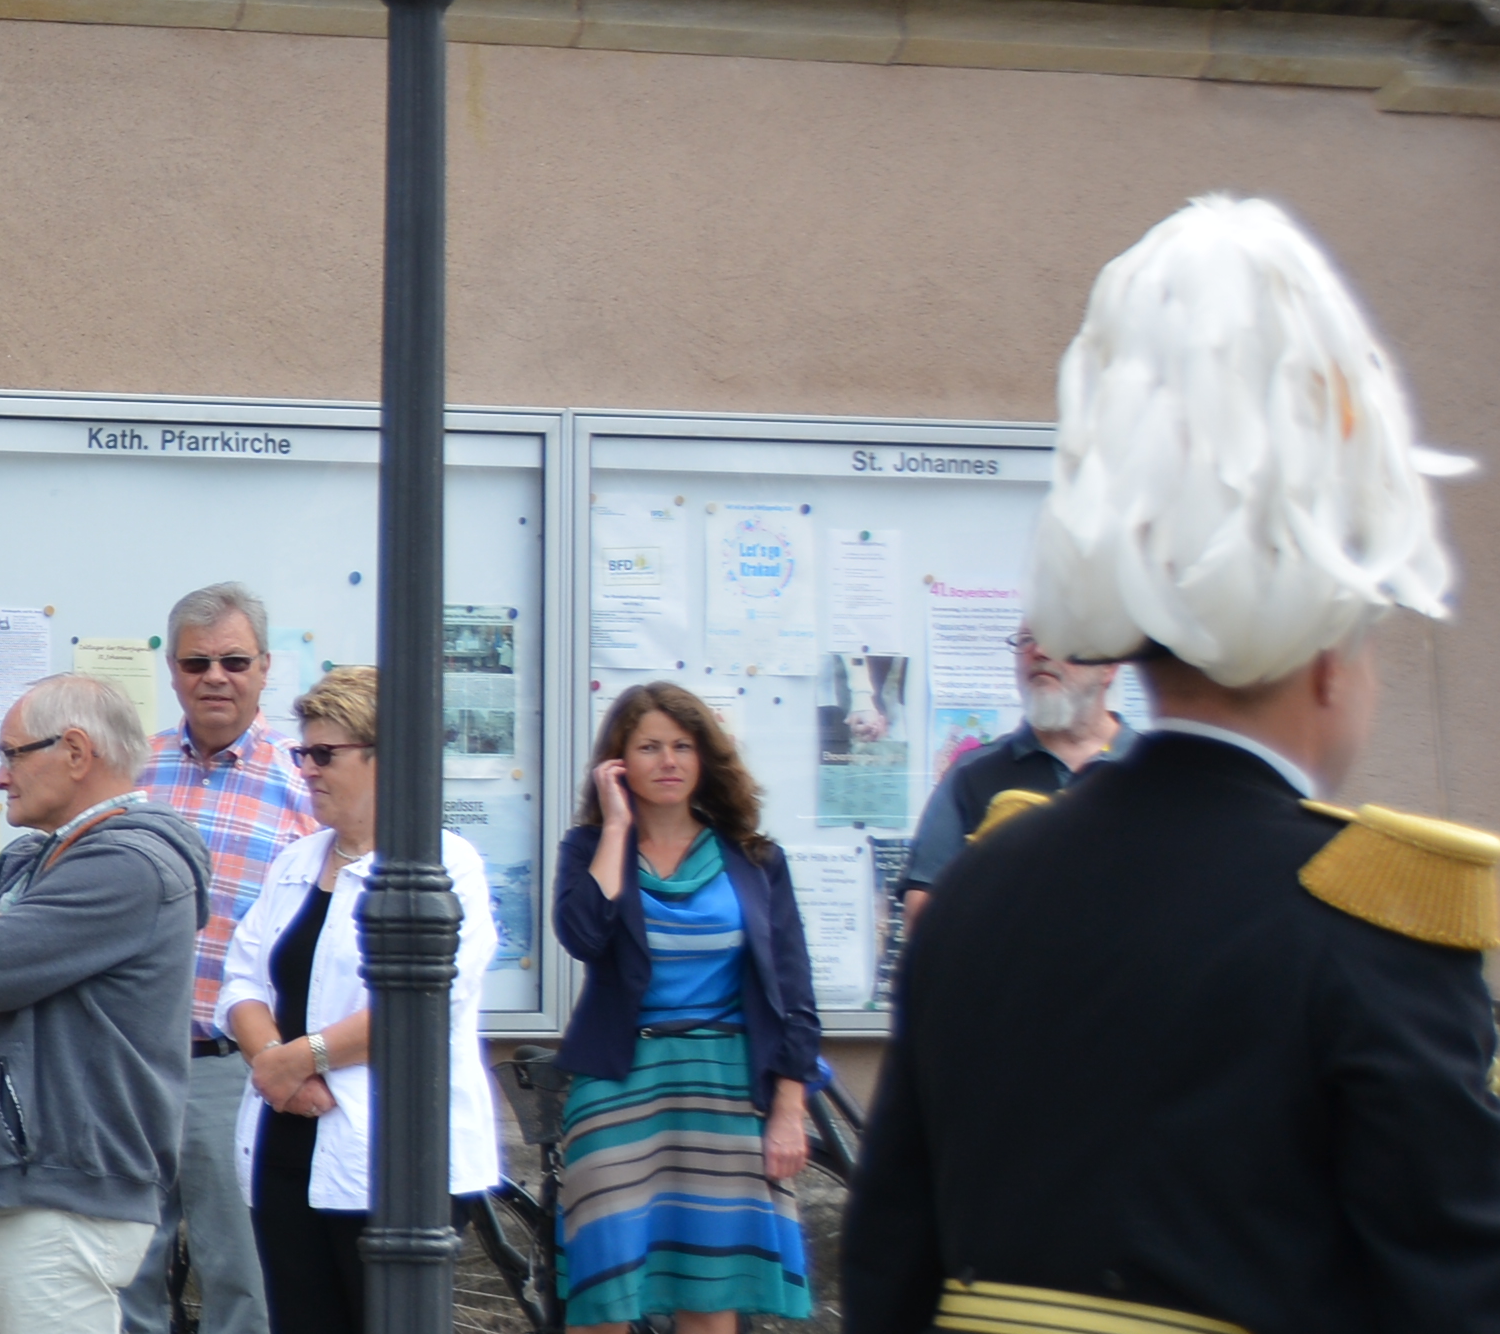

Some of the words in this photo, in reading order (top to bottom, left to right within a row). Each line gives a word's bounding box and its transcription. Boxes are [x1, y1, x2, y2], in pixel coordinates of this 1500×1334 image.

[87, 427, 148, 450] Kath.
[160, 429, 291, 455] Pfarrkirche
[852, 450, 883, 472] St.
[893, 451, 998, 475] Johannes
[609, 559, 633, 571] BFD
[442, 813, 488, 824] ASTROPHE
